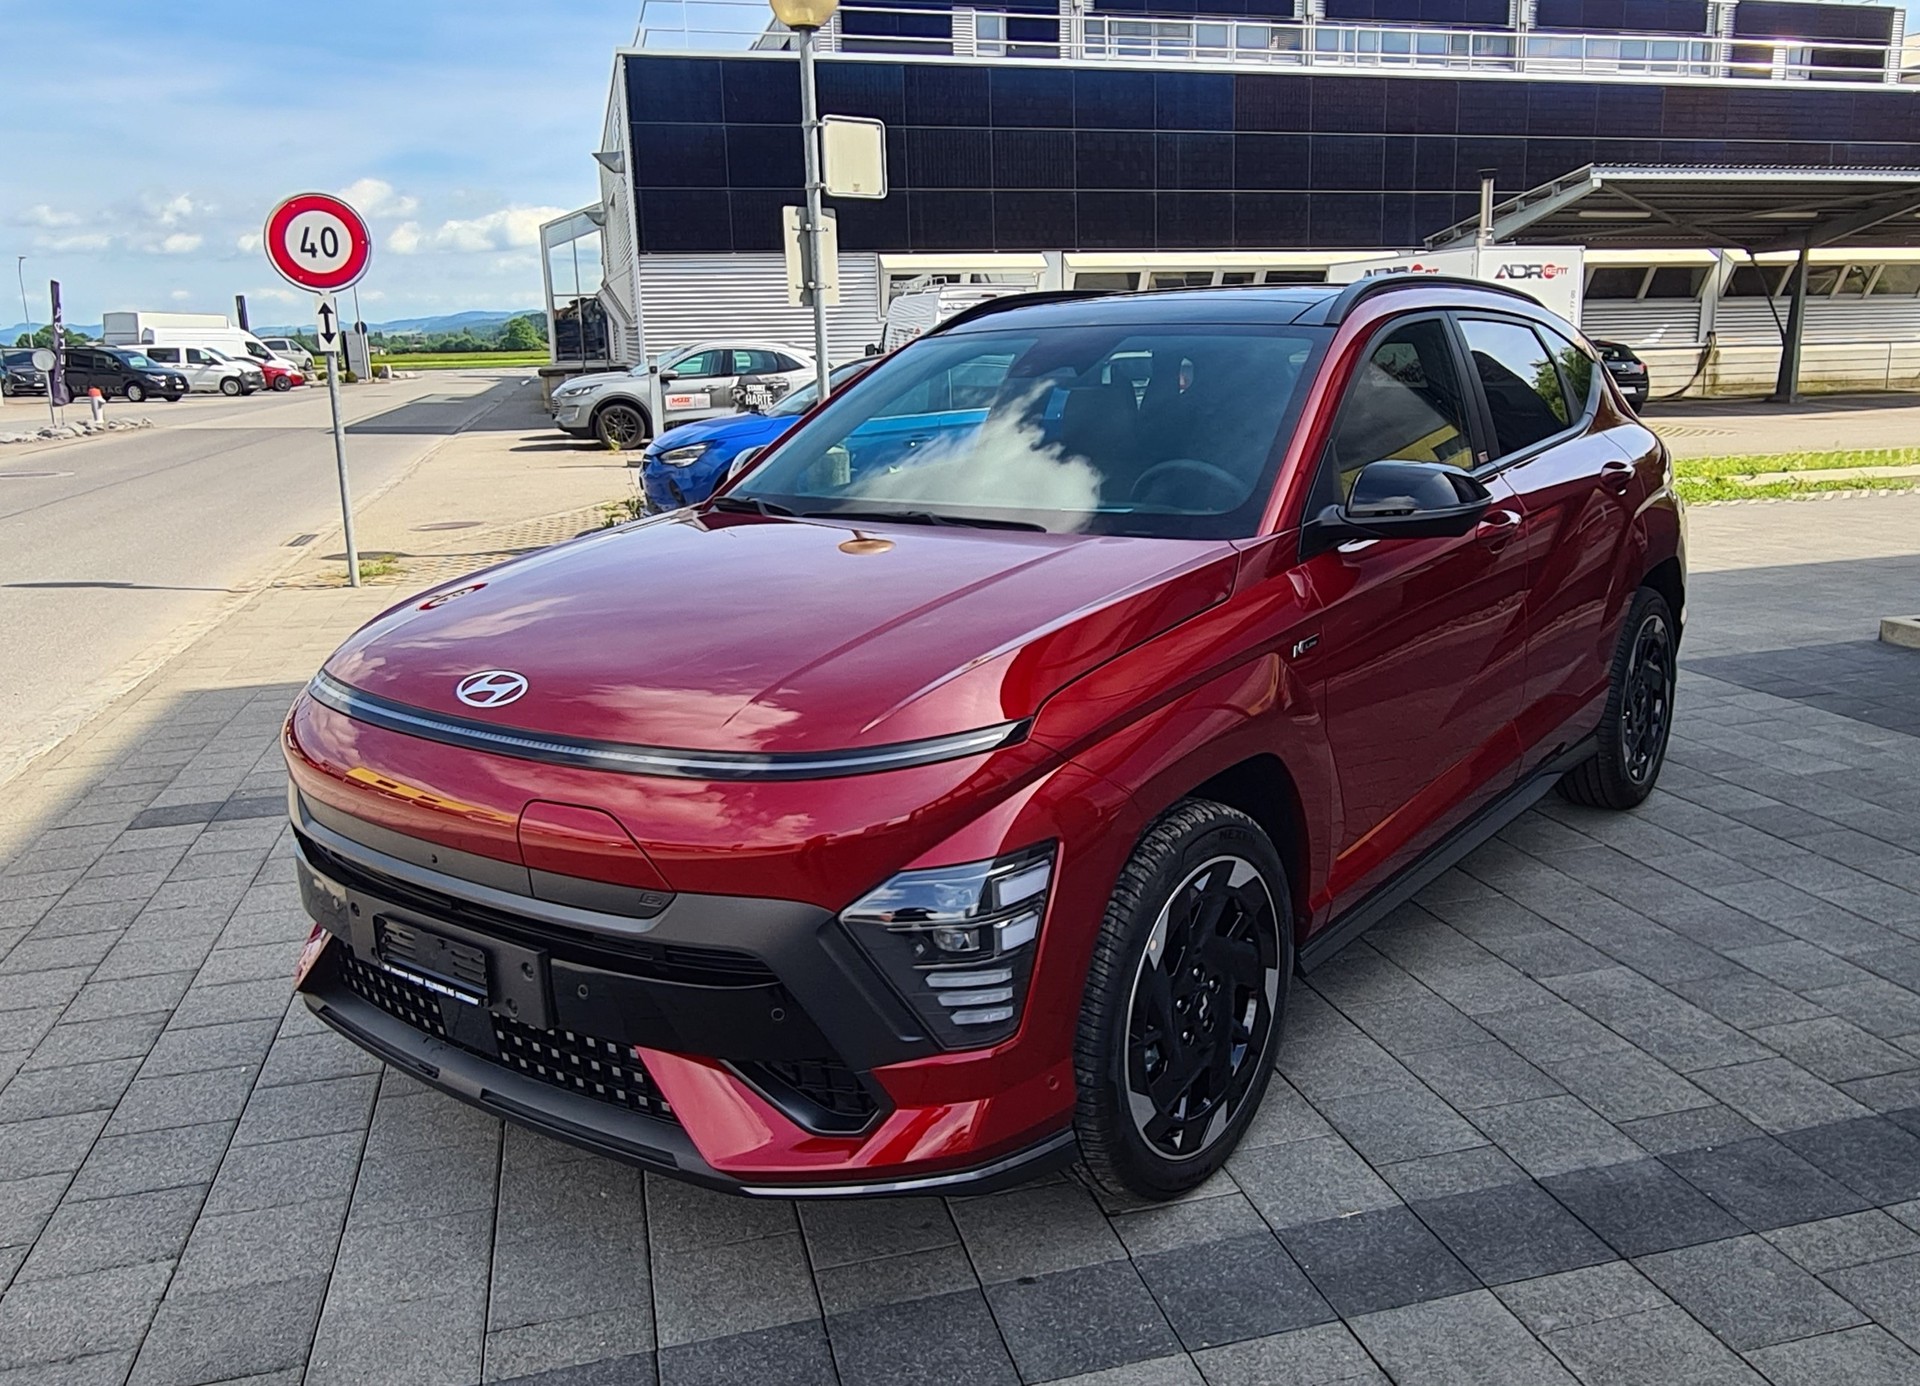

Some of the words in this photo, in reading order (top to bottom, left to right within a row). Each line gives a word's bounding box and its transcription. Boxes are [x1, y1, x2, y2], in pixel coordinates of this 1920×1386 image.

[300, 226, 339, 258] 40
[1494, 264, 1544, 279] ADR
[745, 392, 774, 406] HARTE
